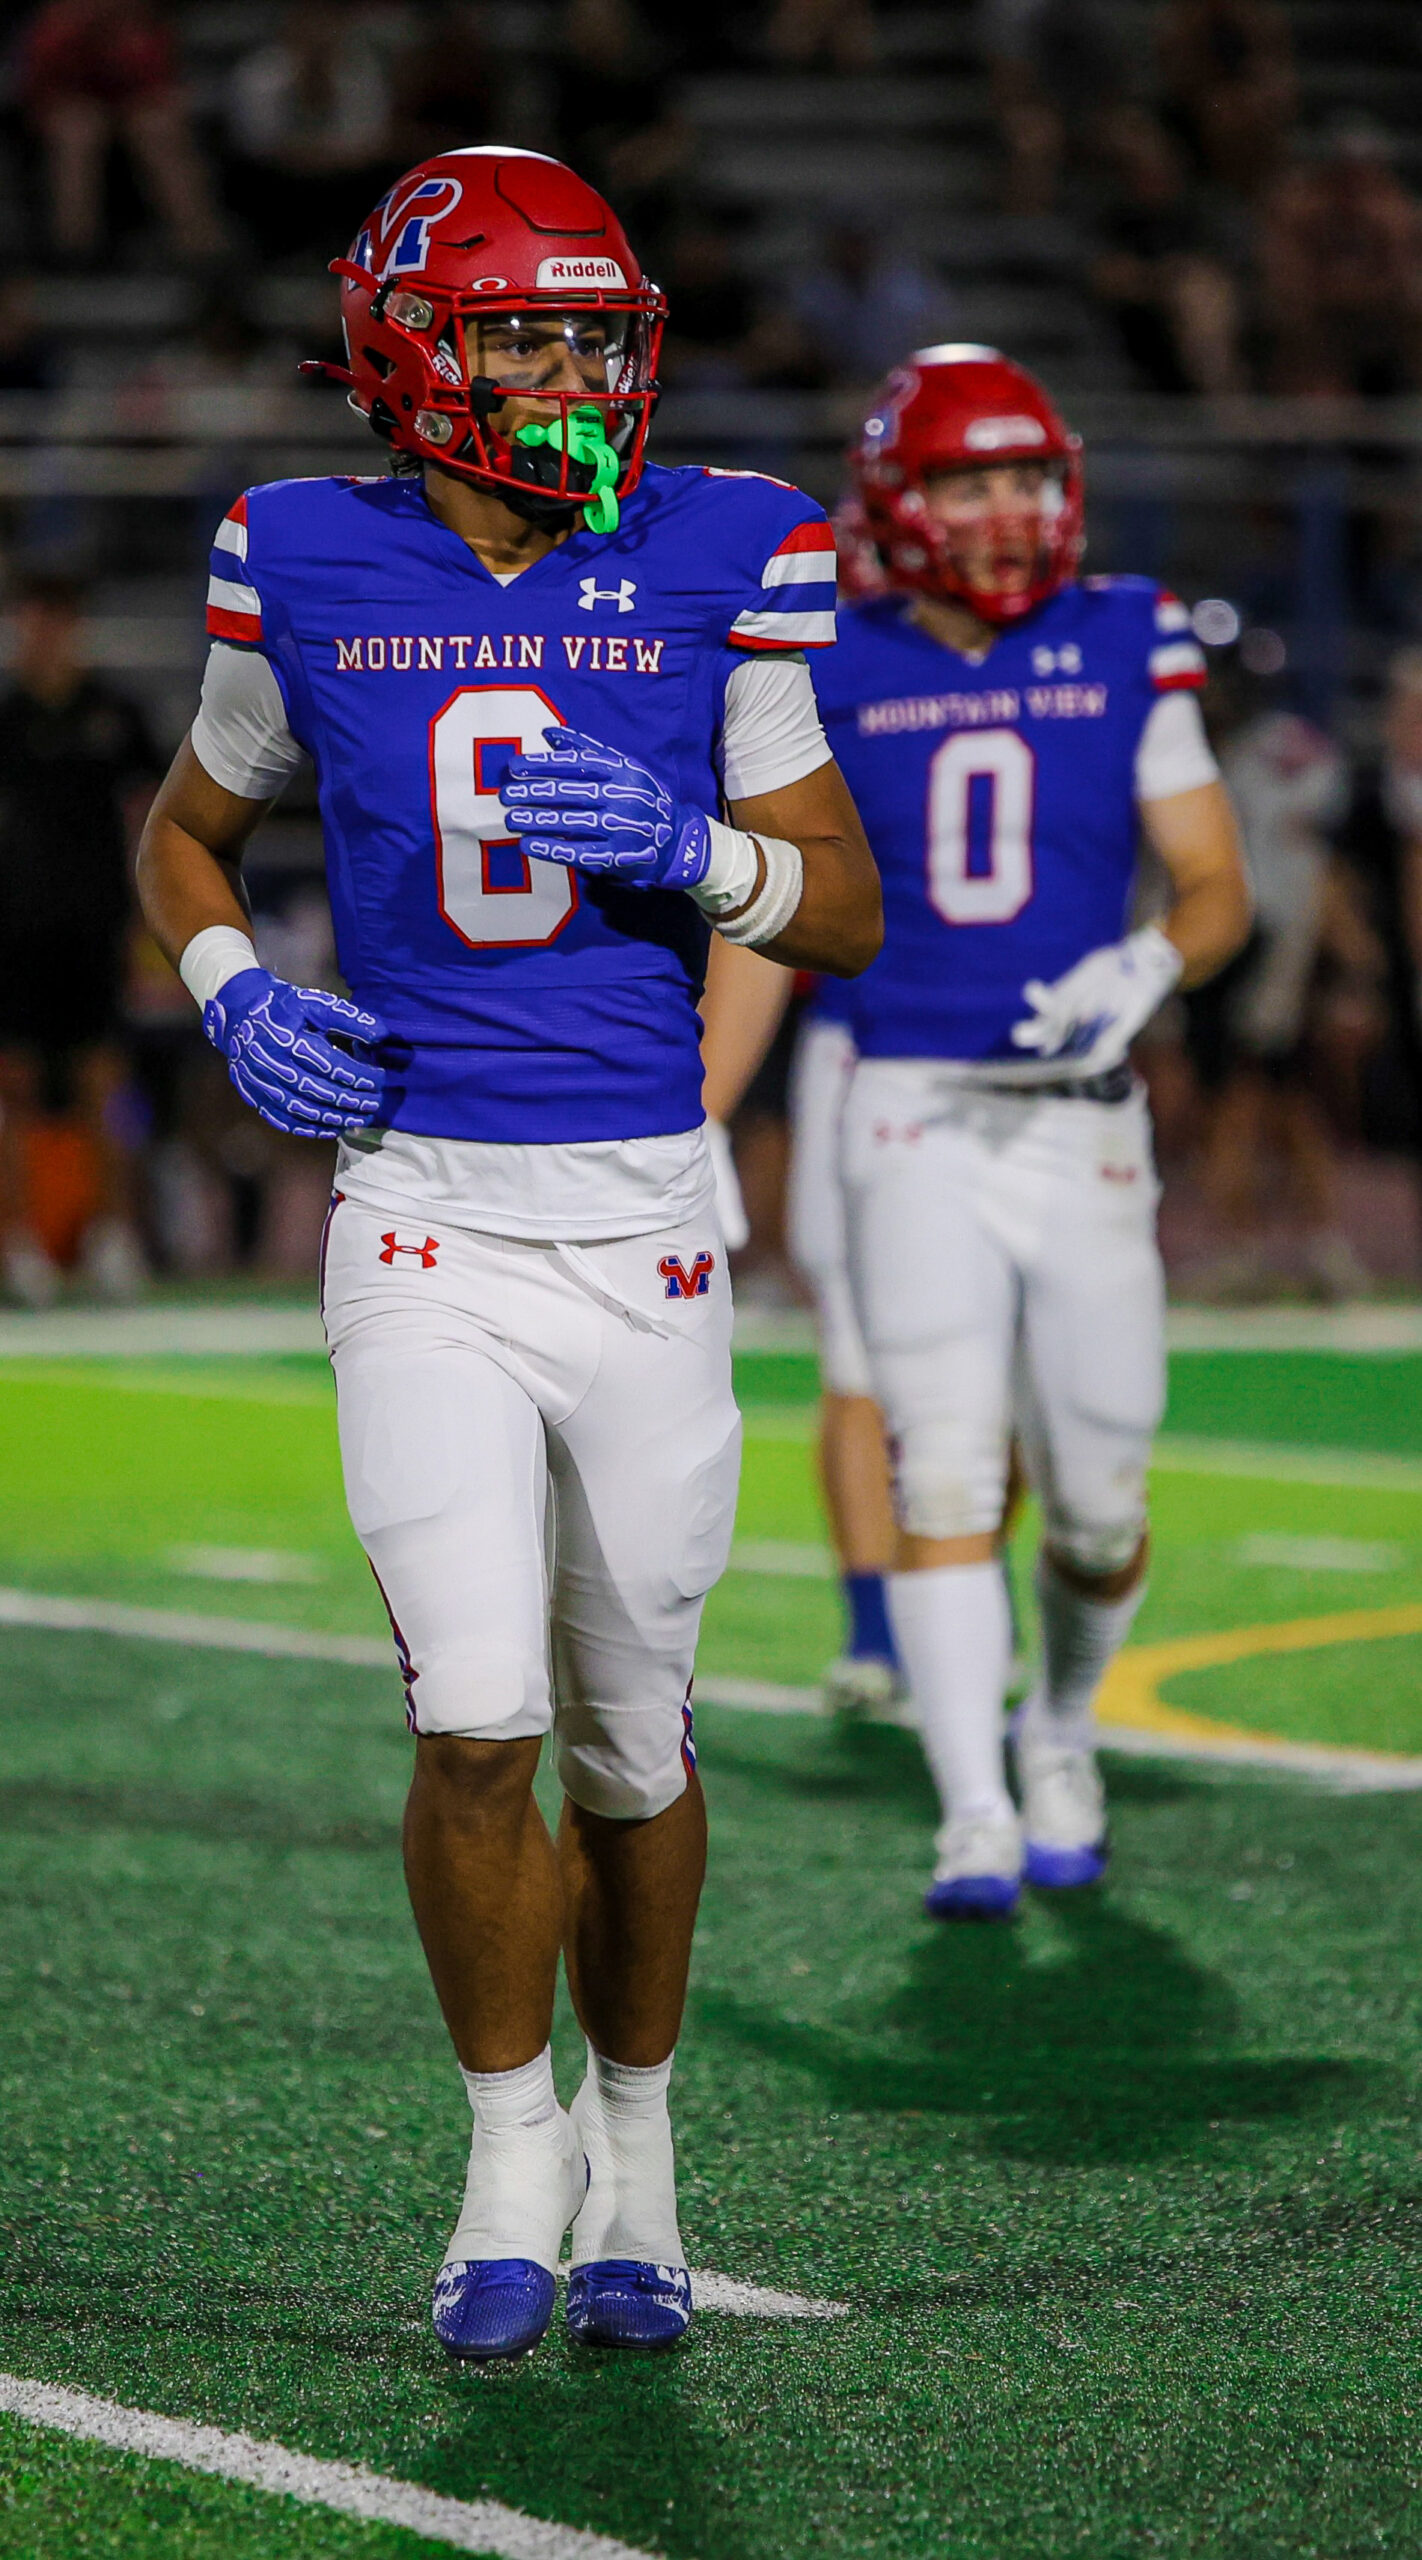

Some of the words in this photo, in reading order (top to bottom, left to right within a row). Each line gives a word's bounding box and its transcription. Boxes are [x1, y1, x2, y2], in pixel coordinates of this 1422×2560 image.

[550, 262, 616, 277] Riddell
[334, 634, 544, 671] MOUNTAIN
[562, 636, 664, 674] VIEW
[857, 689, 1021, 738] MOUNTAIN
[1025, 682, 1108, 720] VIEW
[925, 728, 1036, 925] 0
